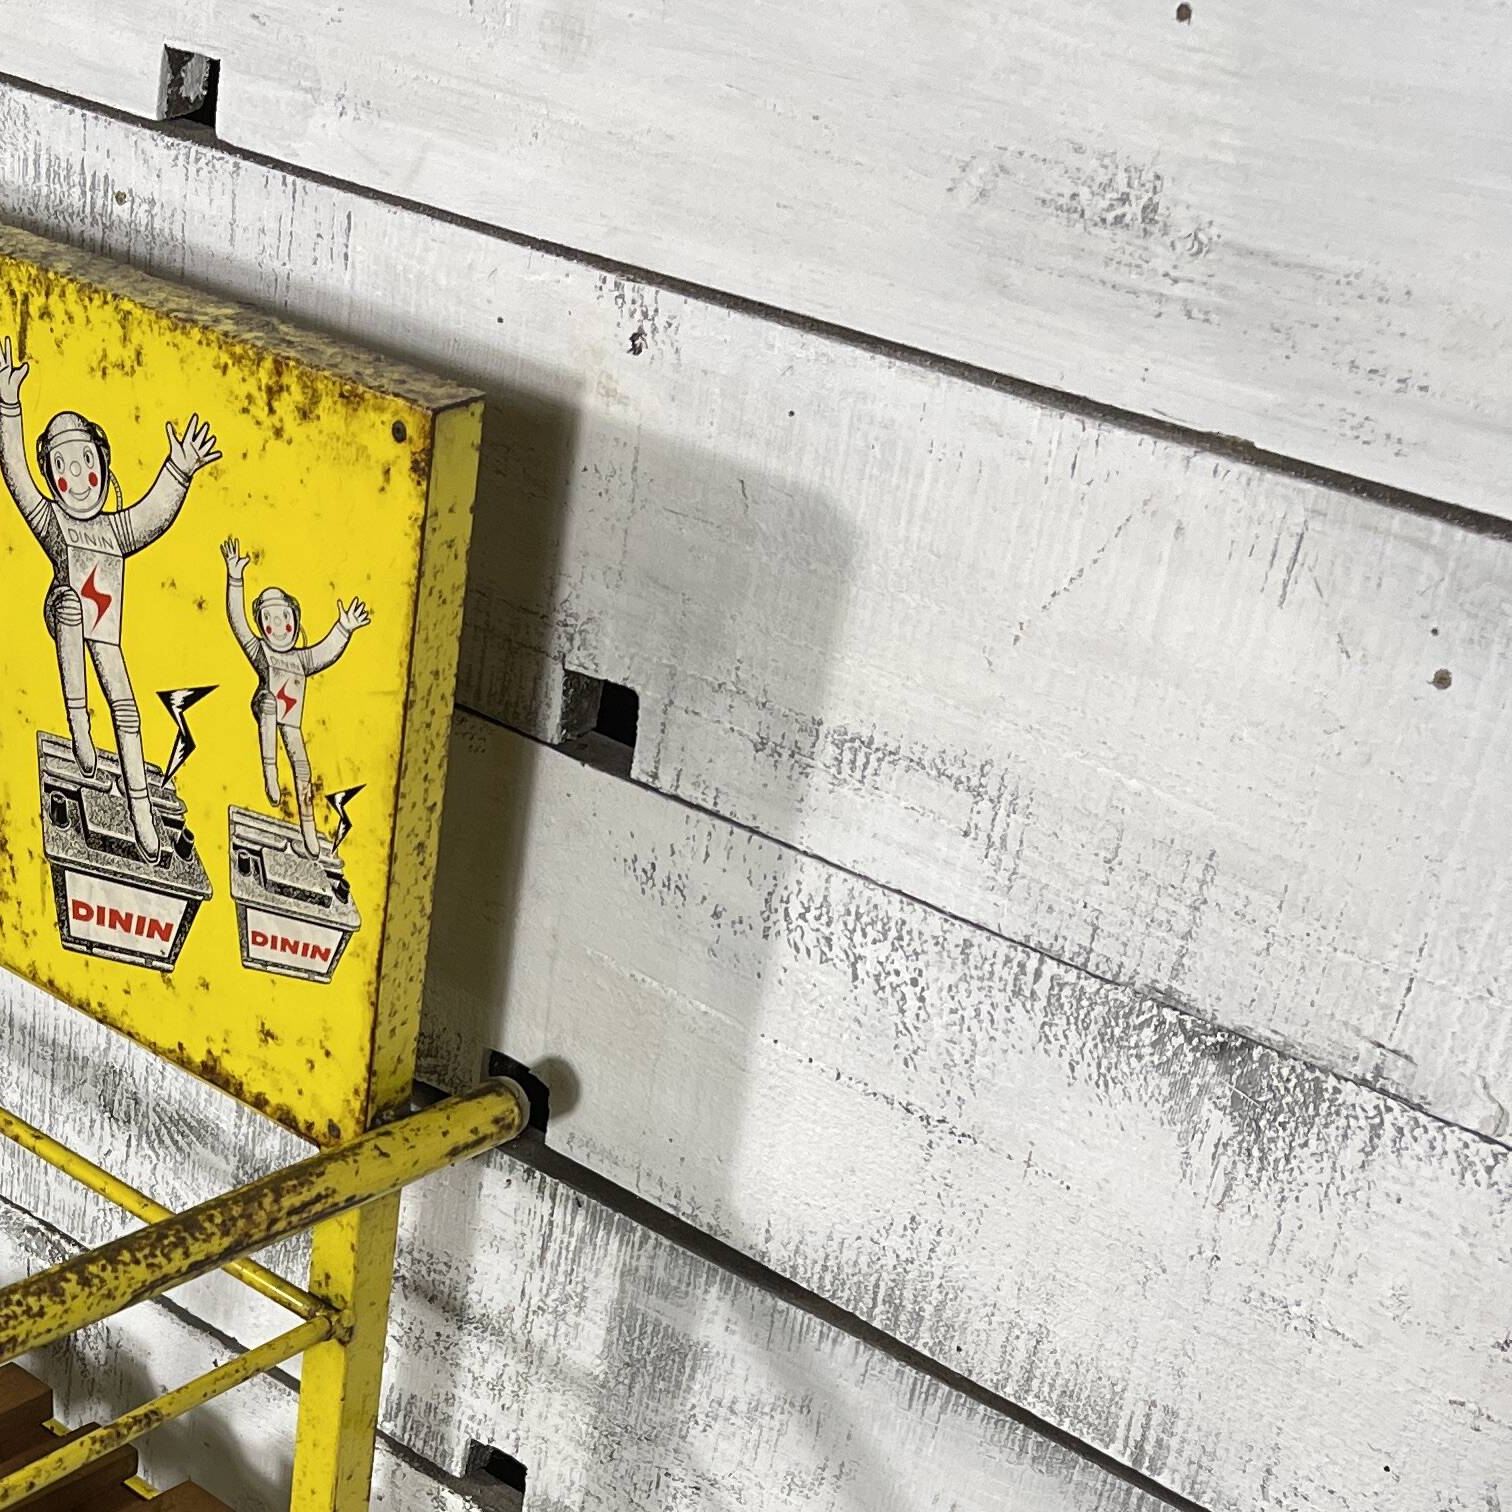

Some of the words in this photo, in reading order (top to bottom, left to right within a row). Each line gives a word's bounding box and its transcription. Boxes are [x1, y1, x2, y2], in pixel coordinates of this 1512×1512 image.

[67, 527, 115, 550] DININ
[72, 899, 174, 942] DININ
[251, 930, 331, 962] DININ
